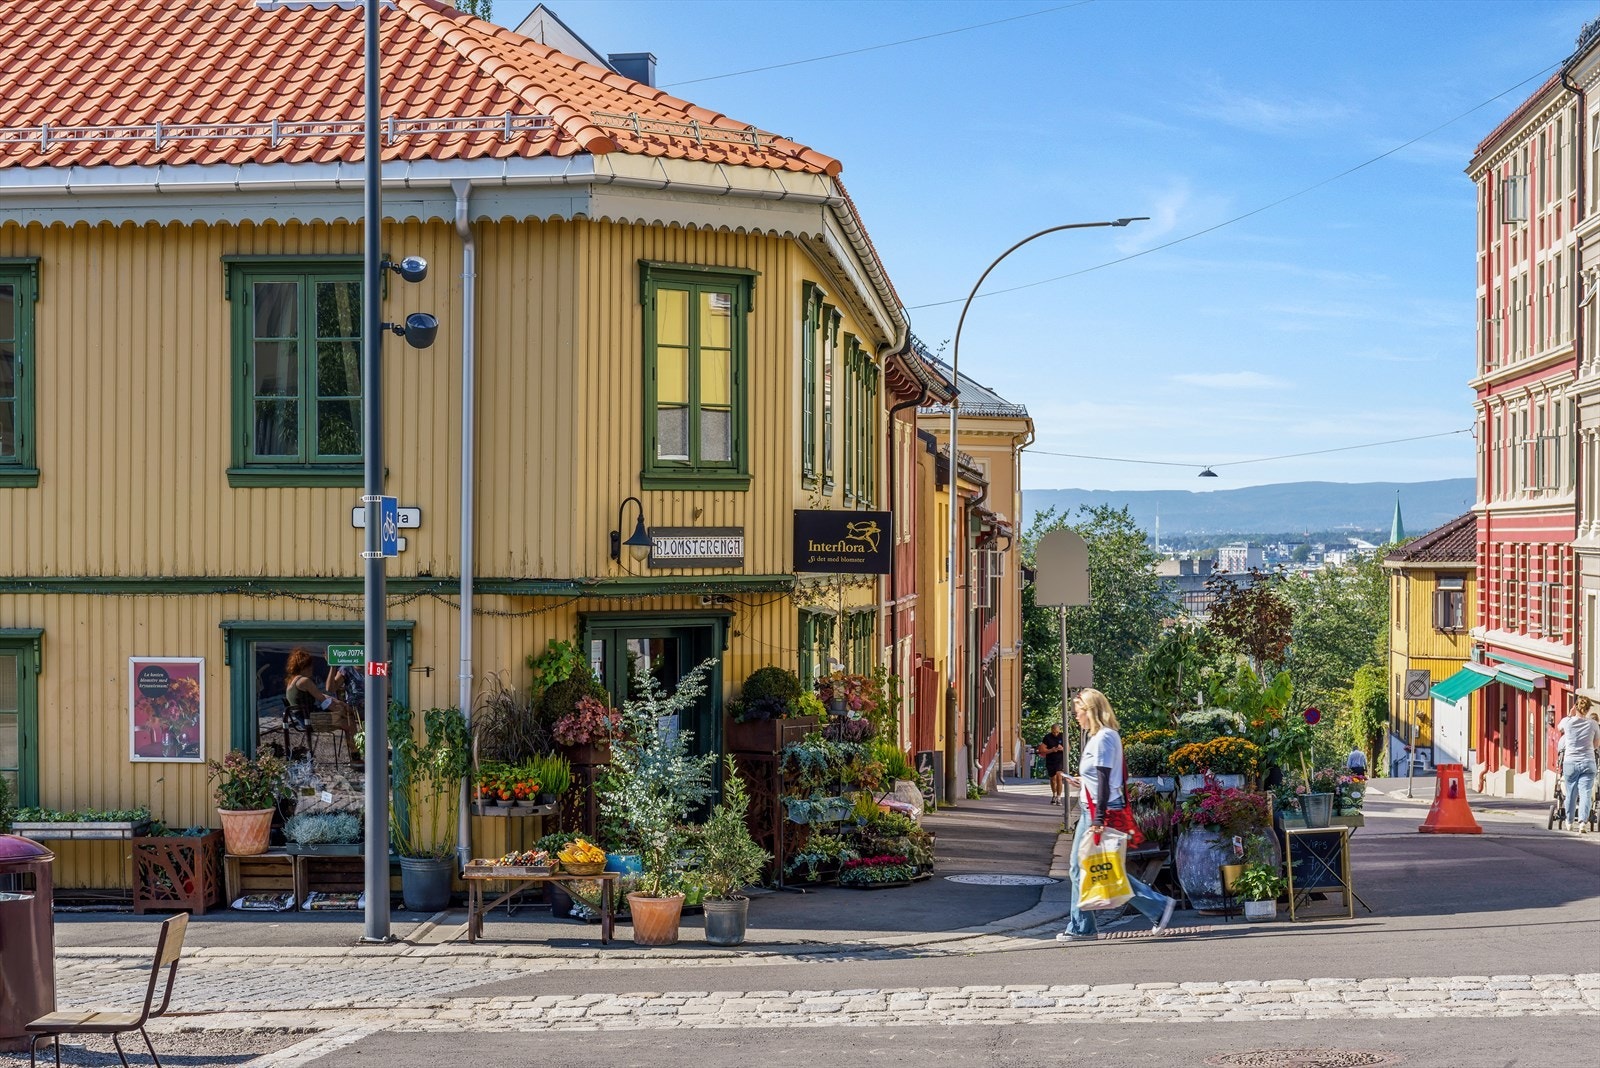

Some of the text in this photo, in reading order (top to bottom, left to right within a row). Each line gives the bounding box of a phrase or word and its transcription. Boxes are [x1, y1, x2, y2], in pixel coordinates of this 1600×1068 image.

[656, 539, 740, 555] BLOMSTERENGA
[808, 539, 866, 553] Interflora
[808, 555, 816, 564] Si
[332, 650, 347, 658] Vipps
